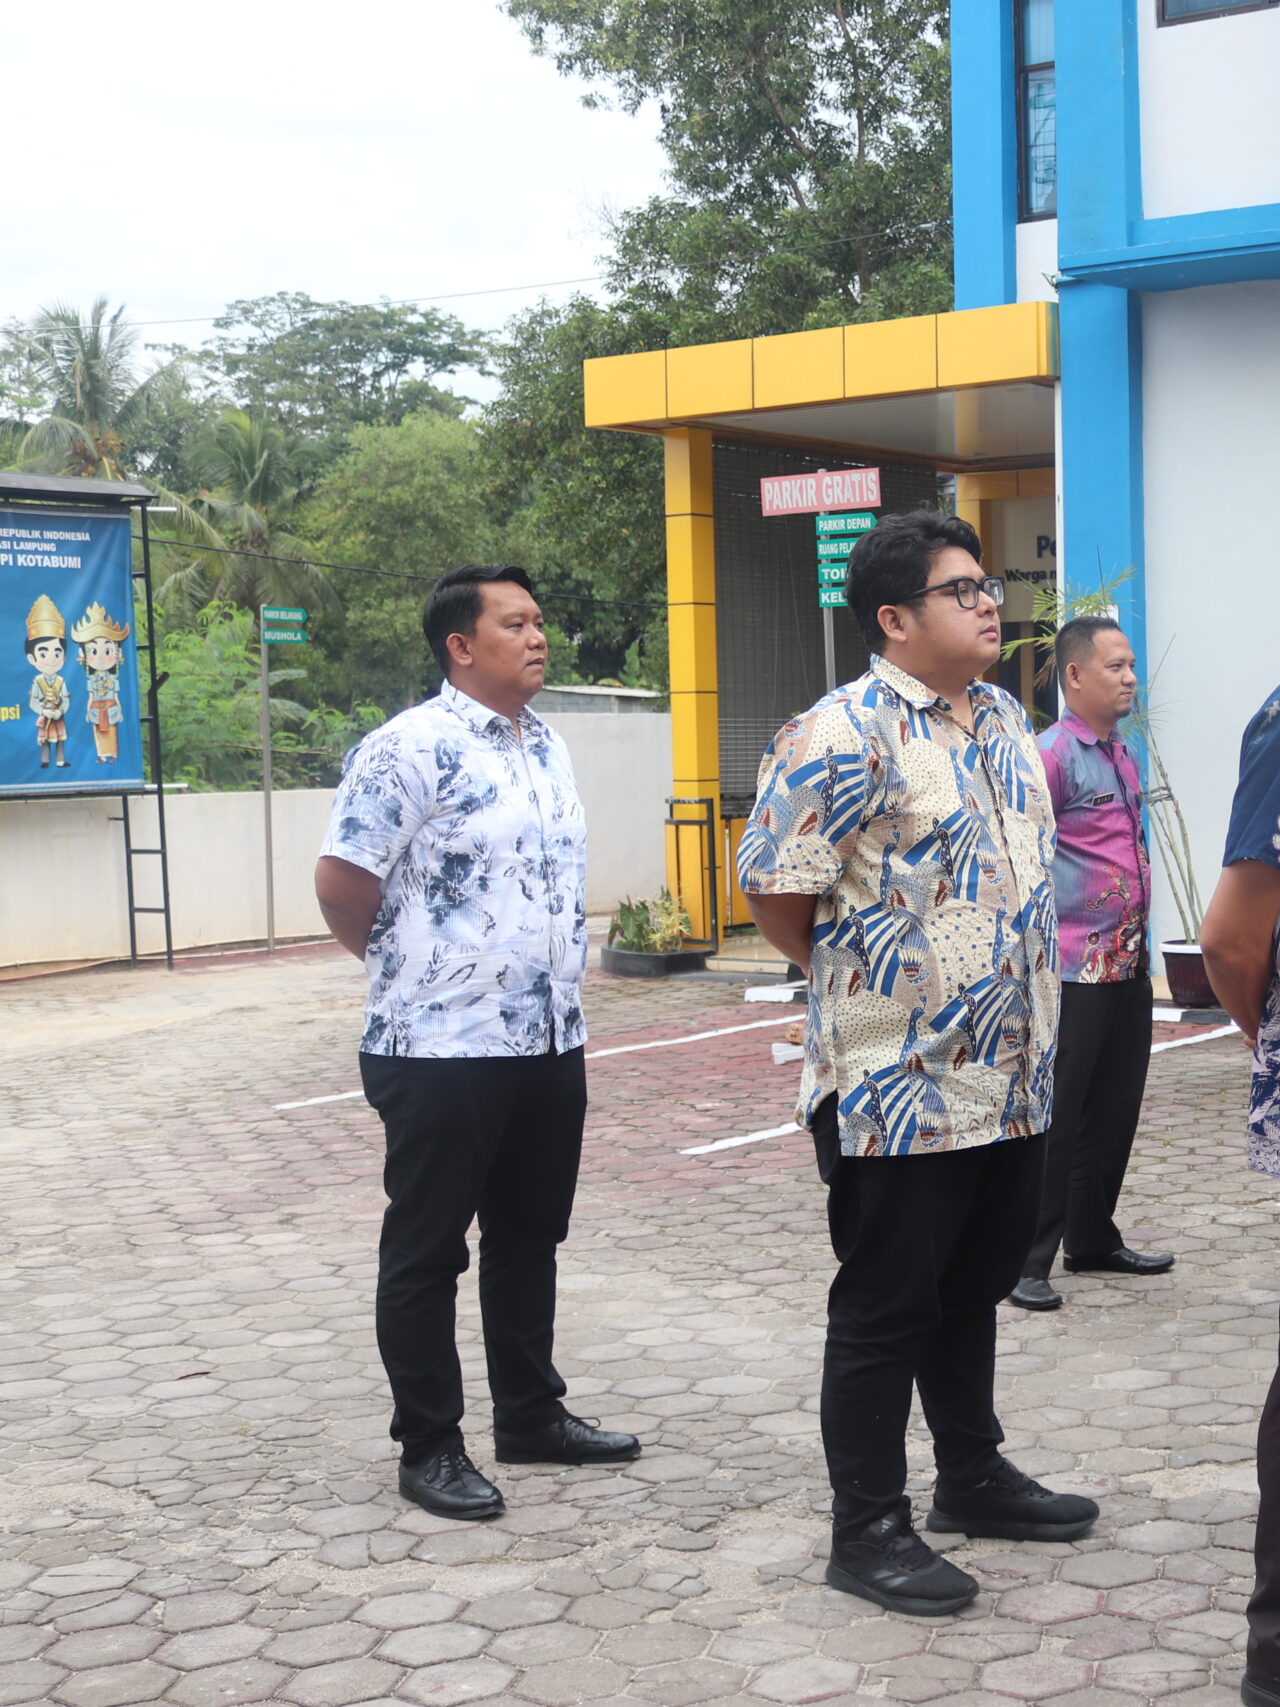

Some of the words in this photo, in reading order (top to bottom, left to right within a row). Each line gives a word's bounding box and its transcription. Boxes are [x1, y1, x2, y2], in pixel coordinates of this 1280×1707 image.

[764, 478, 817, 511] PARKIR
[822, 472, 877, 505] GRATIS
[819, 519, 846, 532] PARKIR
[847, 517, 871, 529] DEPAN
[43, 530, 91, 542] INDONESIA
[0, 540, 11, 550] SI
[13, 541, 57, 552] LAMPUNG
[819, 543, 838, 555] RUANG
[17, 554, 81, 569] KOTABUMI
[821, 567, 848, 580] TOI
[1004, 568, 1046, 584] Warga
[821, 591, 847, 604] KEL
[0, 704, 20, 722] psi
